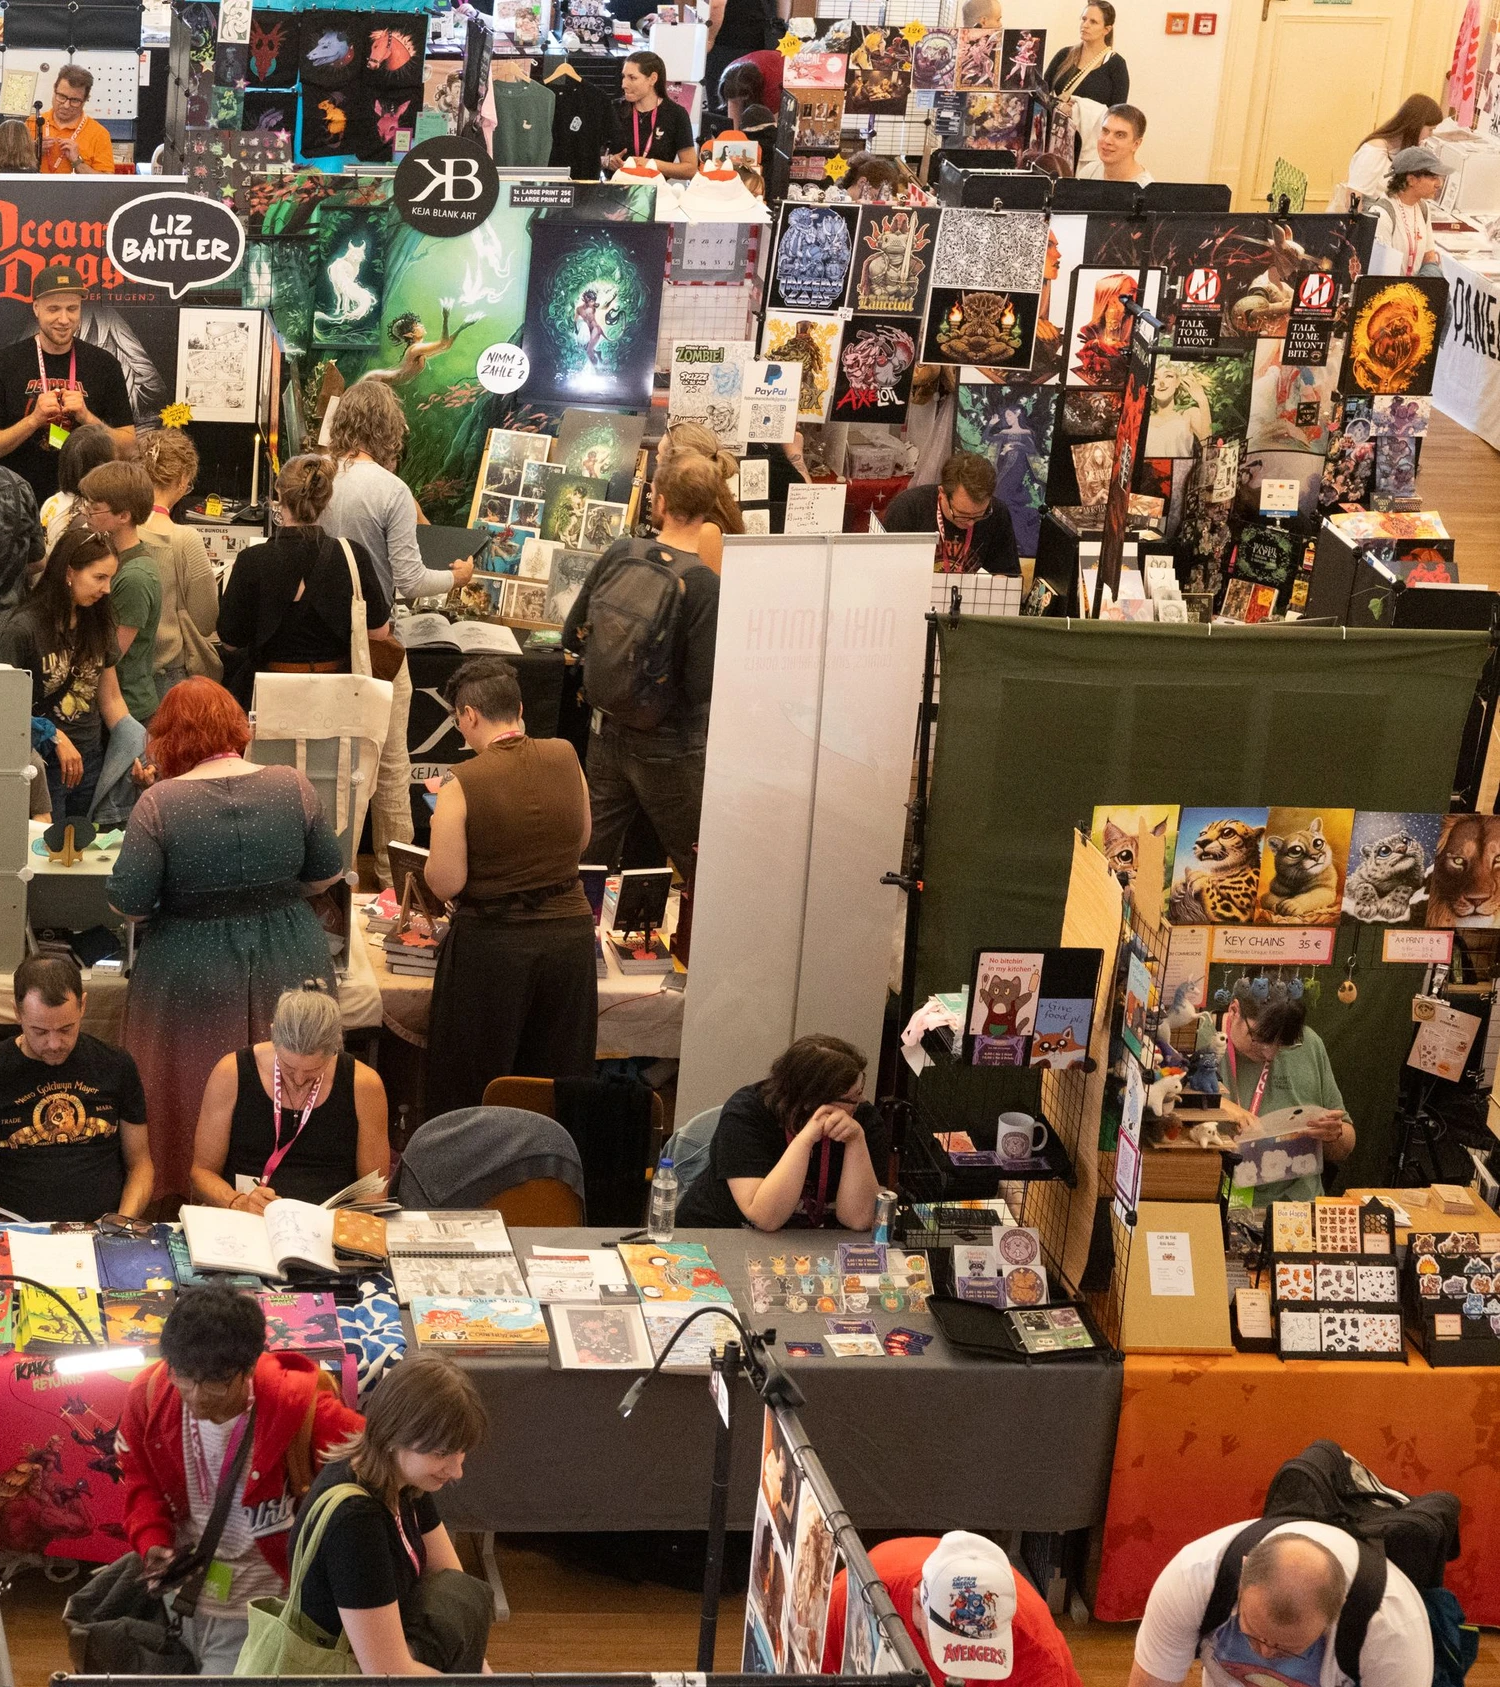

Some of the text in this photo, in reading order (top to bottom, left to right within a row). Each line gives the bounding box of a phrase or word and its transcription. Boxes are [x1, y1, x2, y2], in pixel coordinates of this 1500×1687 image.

[412, 207, 477, 220] KEJA BLANK ART
[149, 214, 192, 236] LIZ
[122, 237, 232, 263] BAITLER
[1186, 268, 1218, 303] AI
[1298, 273, 1332, 308] AI
[108, 293, 155, 301] TUGEND
[1180, 319, 1204, 328] TALK
[1292, 324, 1315, 332] TALK
[1179, 328, 1204, 337] TO ME
[1291, 332, 1302, 340] TO
[1182, 337, 1215, 346] WON'T
[1294, 341, 1326, 350] WON'T
[486, 352, 525, 366] NIMM 3
[676, 346, 725, 364] ZOMBIE!
[1288, 350, 1308, 358] BITE
[480, 364, 524, 380] ZAHLE 2
[679, 372, 709, 381] SKIZZE
[754, 386, 787, 397] PayPal
[1253, 542, 1277, 551] WASHI
[1252, 547, 1277, 558] TAPES
[411, 767, 440, 779] KEJA
[1224, 935, 1245, 946] KEY
[1248, 936, 1285, 947] CHAINS
[1298, 939, 1311, 949] 35
[1395, 937, 1405, 945] A4
[1406, 937, 1425, 945] PRINT
[1007, 965, 1031, 973] kitchen
[1048, 1002, 1072, 1013] Give
[1044, 1008, 1066, 1020] food
[14, 1081, 100, 1106] Metro Goldwyn Mayer
[0, 1117, 22, 1126] TRADE
[1290, 1209, 1308, 1220] Happy
[32, 1373, 85, 1392] RETURNS
[952, 1580, 977, 1588] AMERICA
[953, 1575, 977, 1584] CAPTAIN
[943, 1643, 1004, 1664] AVENGERS
